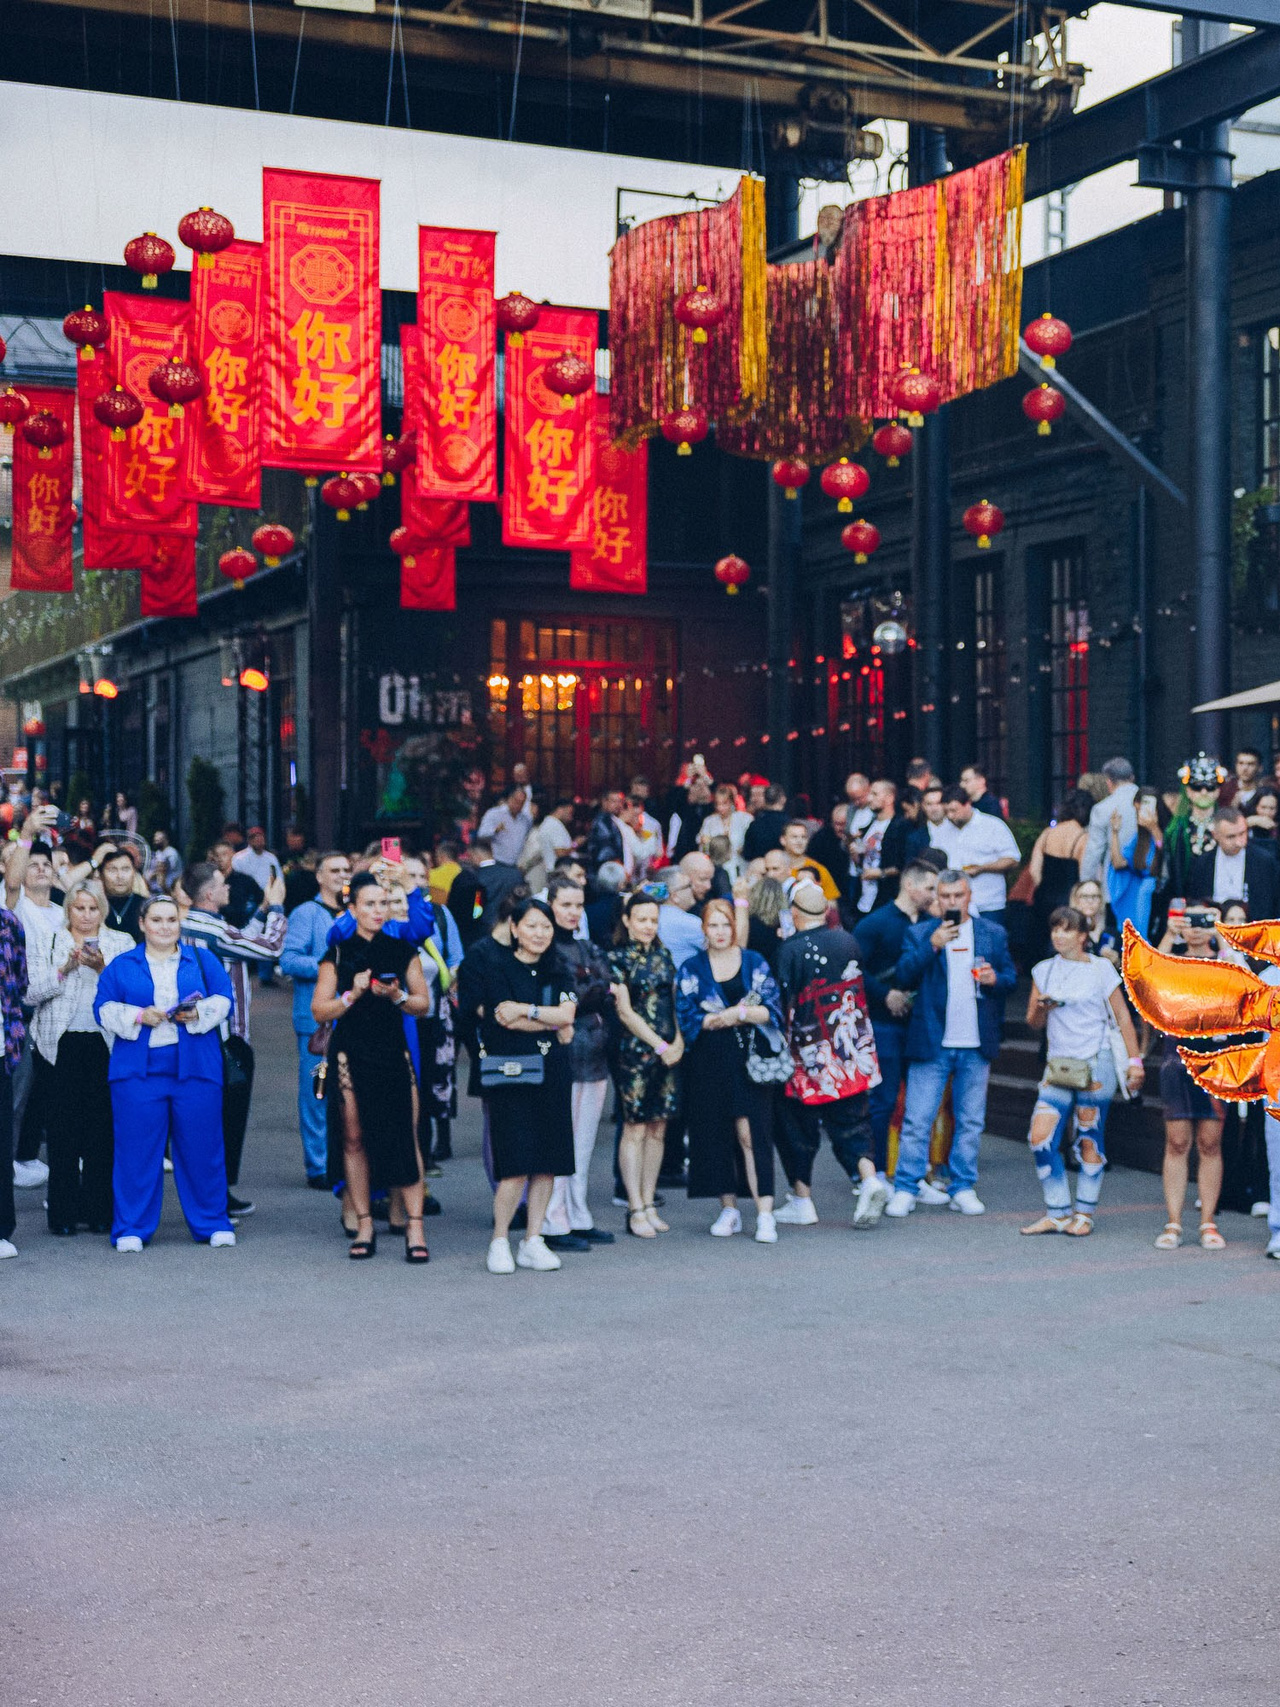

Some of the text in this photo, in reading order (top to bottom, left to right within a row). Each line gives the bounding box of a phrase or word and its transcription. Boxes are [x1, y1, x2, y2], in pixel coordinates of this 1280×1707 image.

[204, 346, 249, 433] 你好
[288, 309, 360, 429] 你好
[437, 343, 480, 430] 你好
[124, 407, 177, 502] 你好
[525, 418, 579, 515] 你好
[28, 472, 60, 535] 你好
[591, 485, 632, 564] 你好
